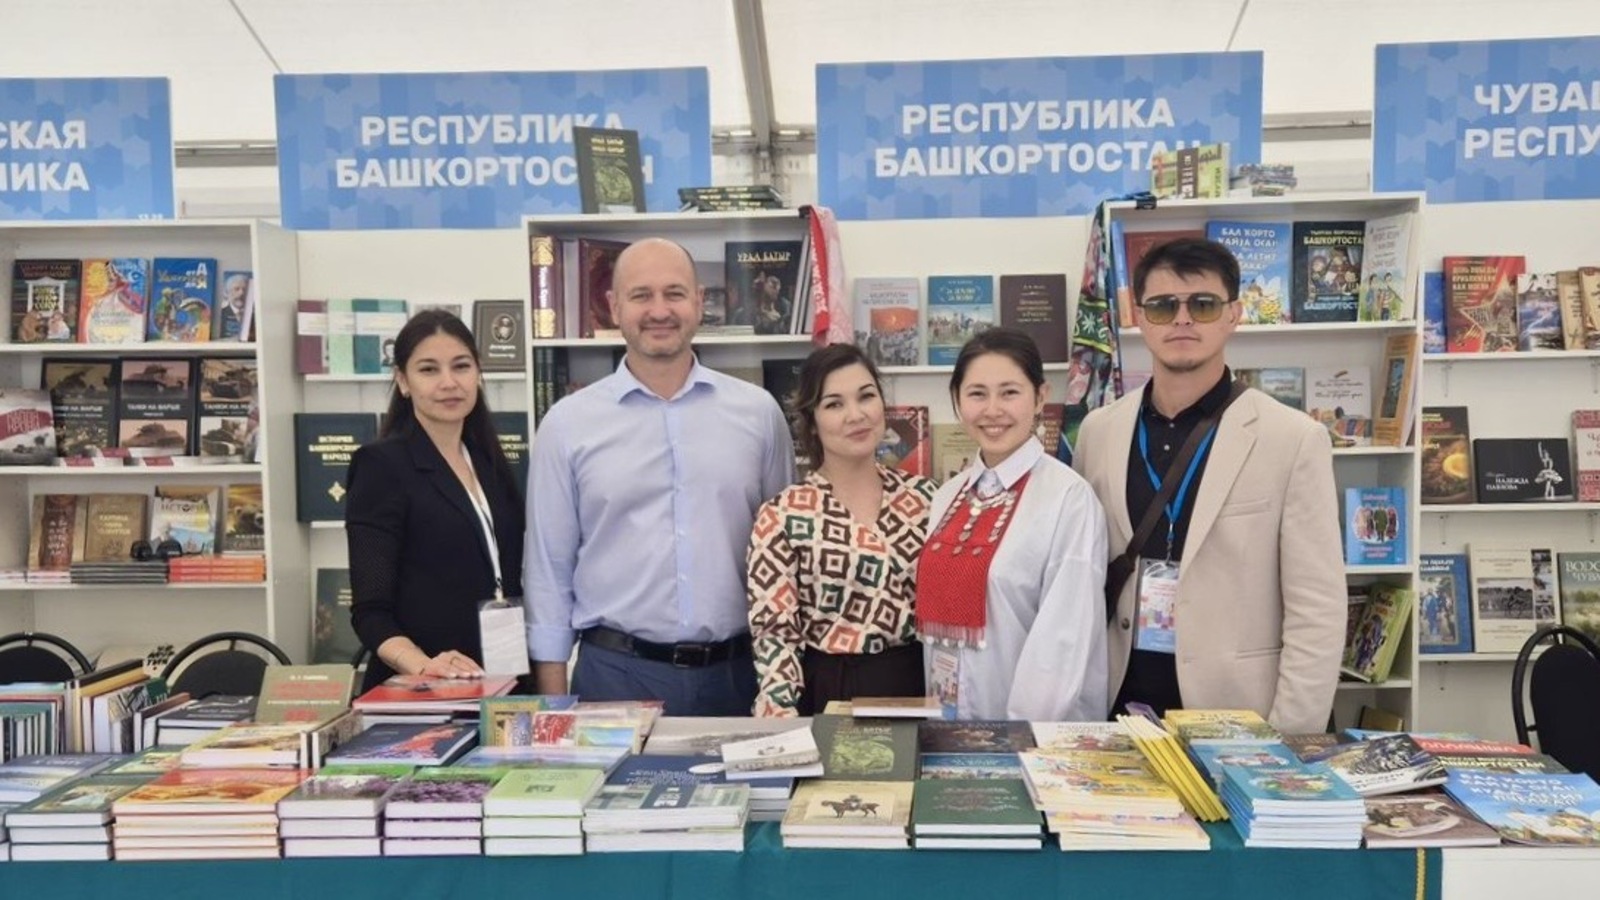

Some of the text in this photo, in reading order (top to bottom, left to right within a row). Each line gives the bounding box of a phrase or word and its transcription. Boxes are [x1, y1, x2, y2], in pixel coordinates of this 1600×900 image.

[1474, 81, 1600, 114] ЧУВА
[902, 98, 1175, 134] РЕСПУБЛИКА
[336, 155, 654, 188] БАШКОРТОС
[1222, 227, 1241, 236] БАЛ
[737, 251, 761, 262] УРАЛ
[308, 444, 362, 452] БАШКИРСКО
